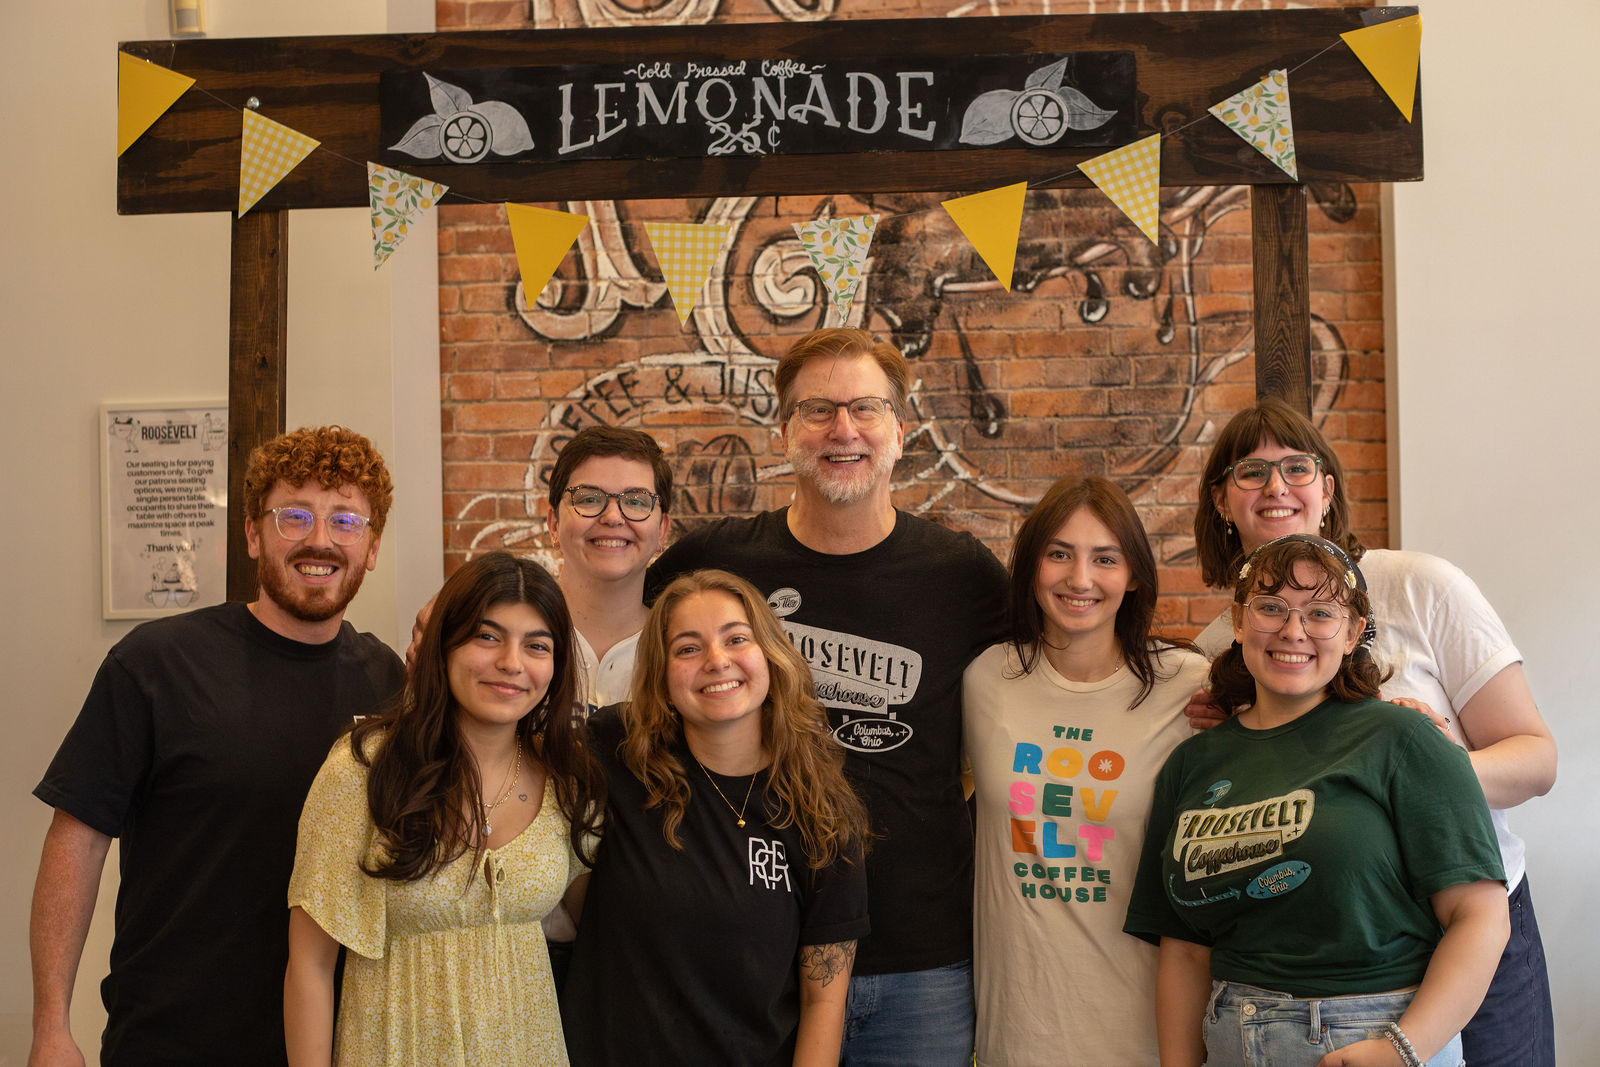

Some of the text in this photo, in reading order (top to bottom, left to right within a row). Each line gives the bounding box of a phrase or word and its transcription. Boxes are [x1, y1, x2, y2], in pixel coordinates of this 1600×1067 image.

[684, 61, 747, 79] Pressed
[558, 71, 937, 155] LEMONADE
[664, 364, 693, 405] &
[701, 361, 780, 419] JUS
[141, 424, 197, 440] ROOSEVELT
[126, 459, 214, 469] Our seating is for paying
[197, 468, 214, 476] give
[148, 478, 177, 486] patrons
[178, 477, 206, 485] seating
[127, 504, 166, 512] occupants
[136, 495, 159, 504] single
[173, 511, 197, 519] others
[128, 521, 163, 529] maximize
[164, 521, 187, 529] space
[196, 520, 215, 528] peak
[147, 543, 174, 552] Thank
[784, 629, 914, 689] OOSEVELT
[860, 736, 884, 747] Ohio
[1053, 725, 1094, 742] THE
[1012, 742, 1125, 781] ROO
[1008, 781, 1119, 822] SEV
[1182, 799, 1307, 839] ROOSEVELT
[1010, 817, 1115, 862] ELT
[1187, 838, 1280, 875] Coffeehouse
[1013, 862, 1111, 885] COFFEE
[1021, 882, 1107, 903] HOUSE
[1268, 880, 1289, 895] Ohio
